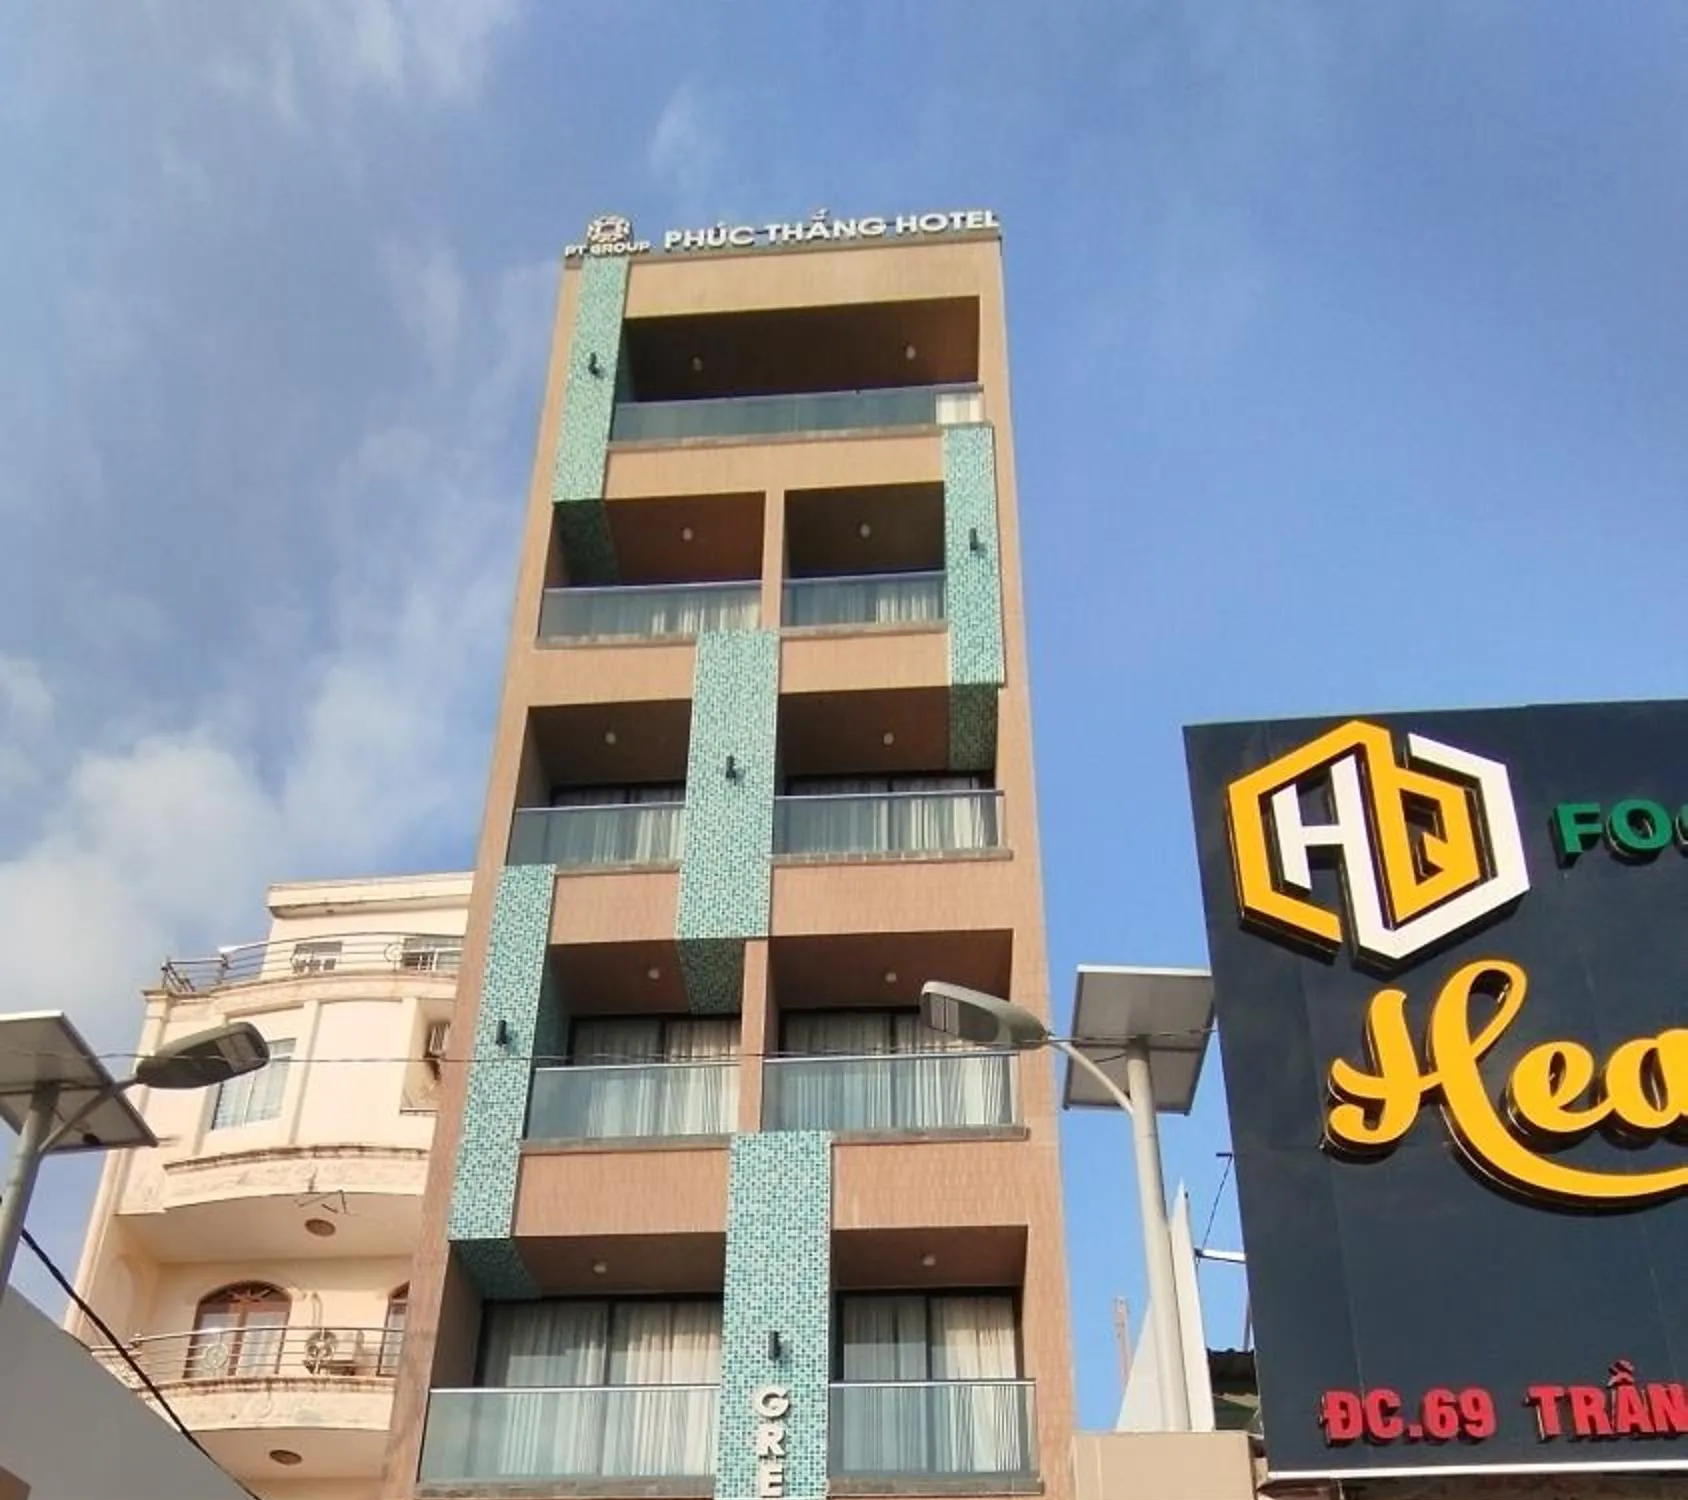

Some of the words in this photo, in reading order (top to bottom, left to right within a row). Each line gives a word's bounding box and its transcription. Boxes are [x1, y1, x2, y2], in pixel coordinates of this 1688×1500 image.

[565, 244, 587, 256] PT
[589, 240, 650, 254] GROUP
[664, 222, 755, 250] PHÚC
[766, 208, 887, 244] THẮNG
[895, 210, 1000, 233] HOTEL
[1552, 799, 1688, 856] FO
[1320, 1387, 1497, 1442] ĐC.69
[1524, 1357, 1688, 1439] TRẦN
